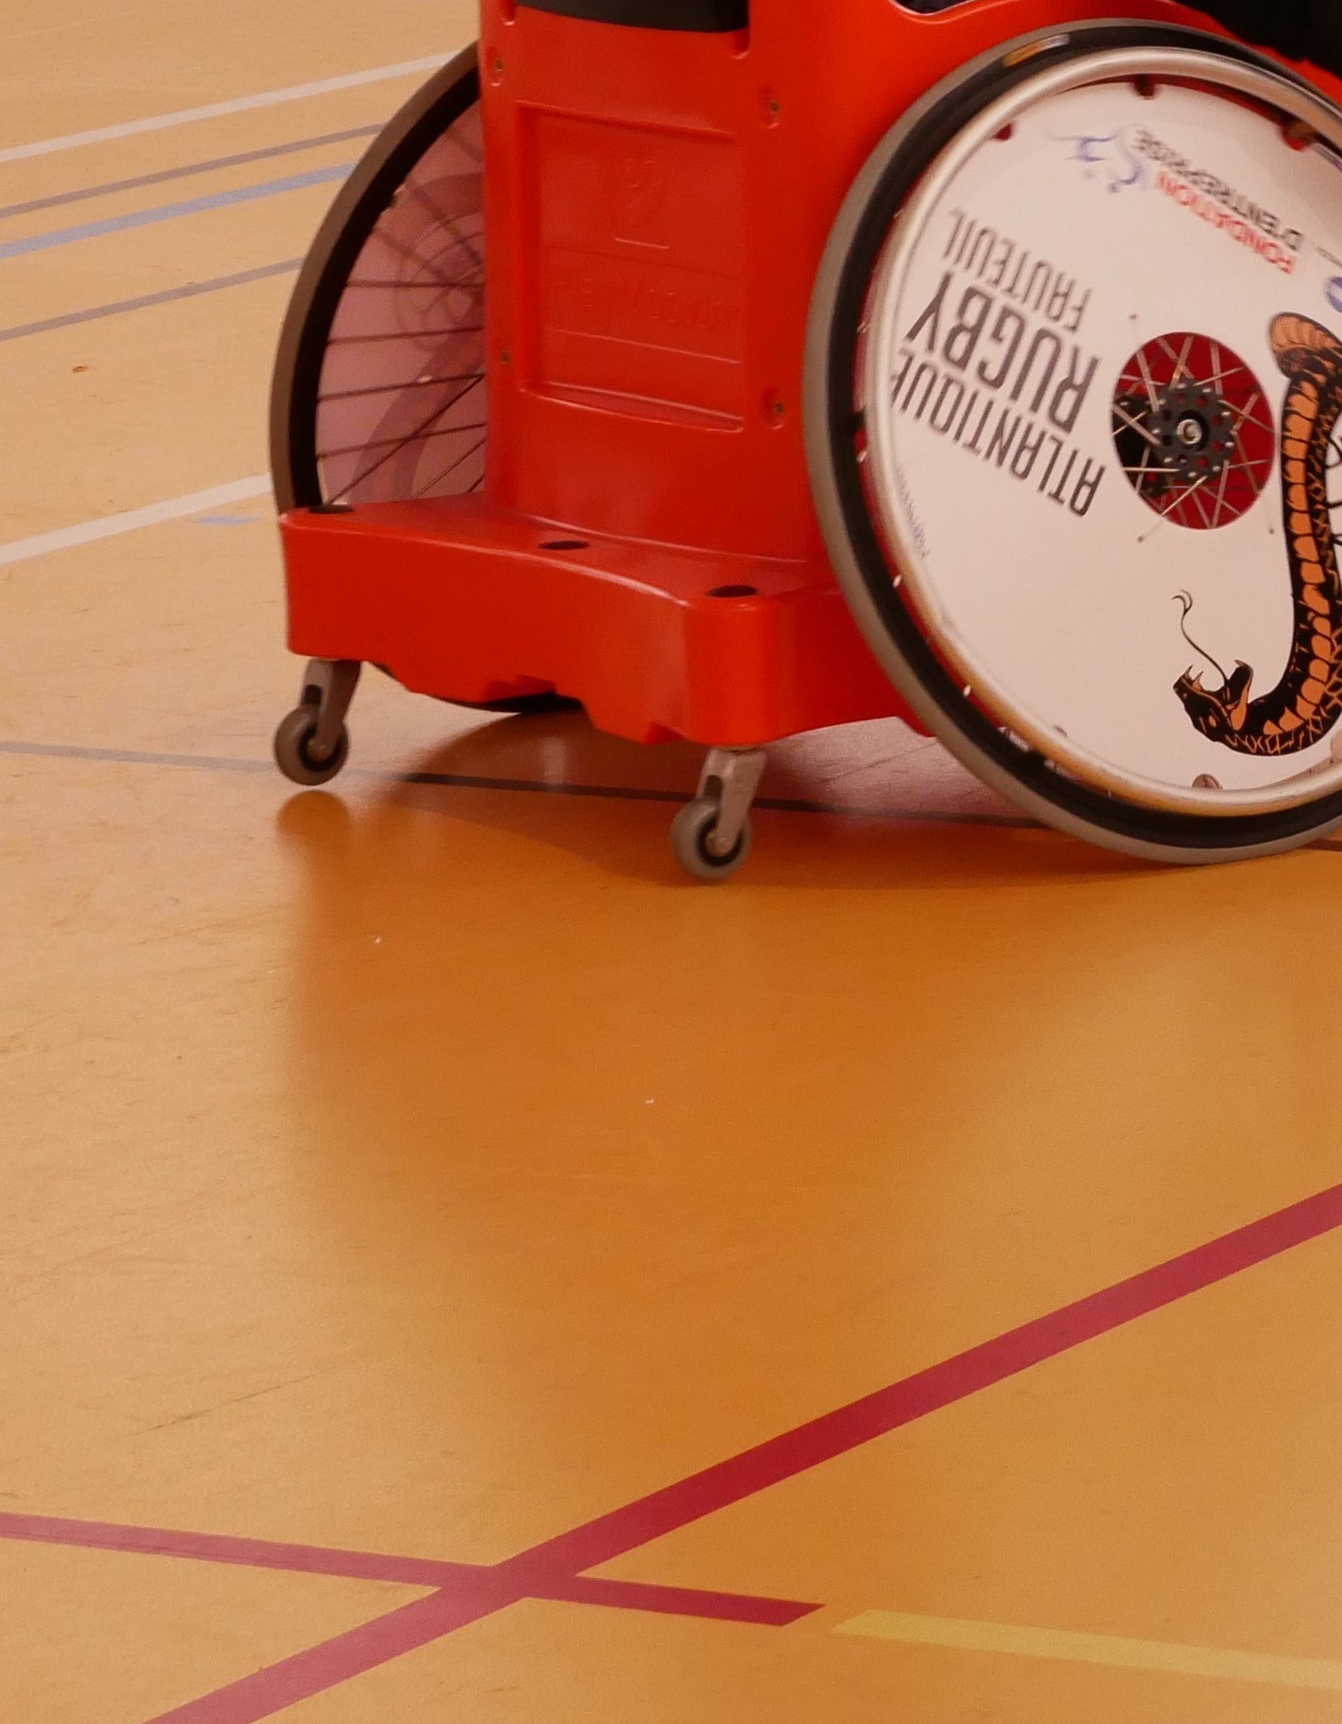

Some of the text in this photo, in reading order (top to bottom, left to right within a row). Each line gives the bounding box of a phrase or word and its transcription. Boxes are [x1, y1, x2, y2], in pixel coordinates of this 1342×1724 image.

[950, 208, 1092, 332] FAUTEUIL
[1155, 171, 1297, 274] FONDATION
[905, 271, 1100, 434] RUGBY
